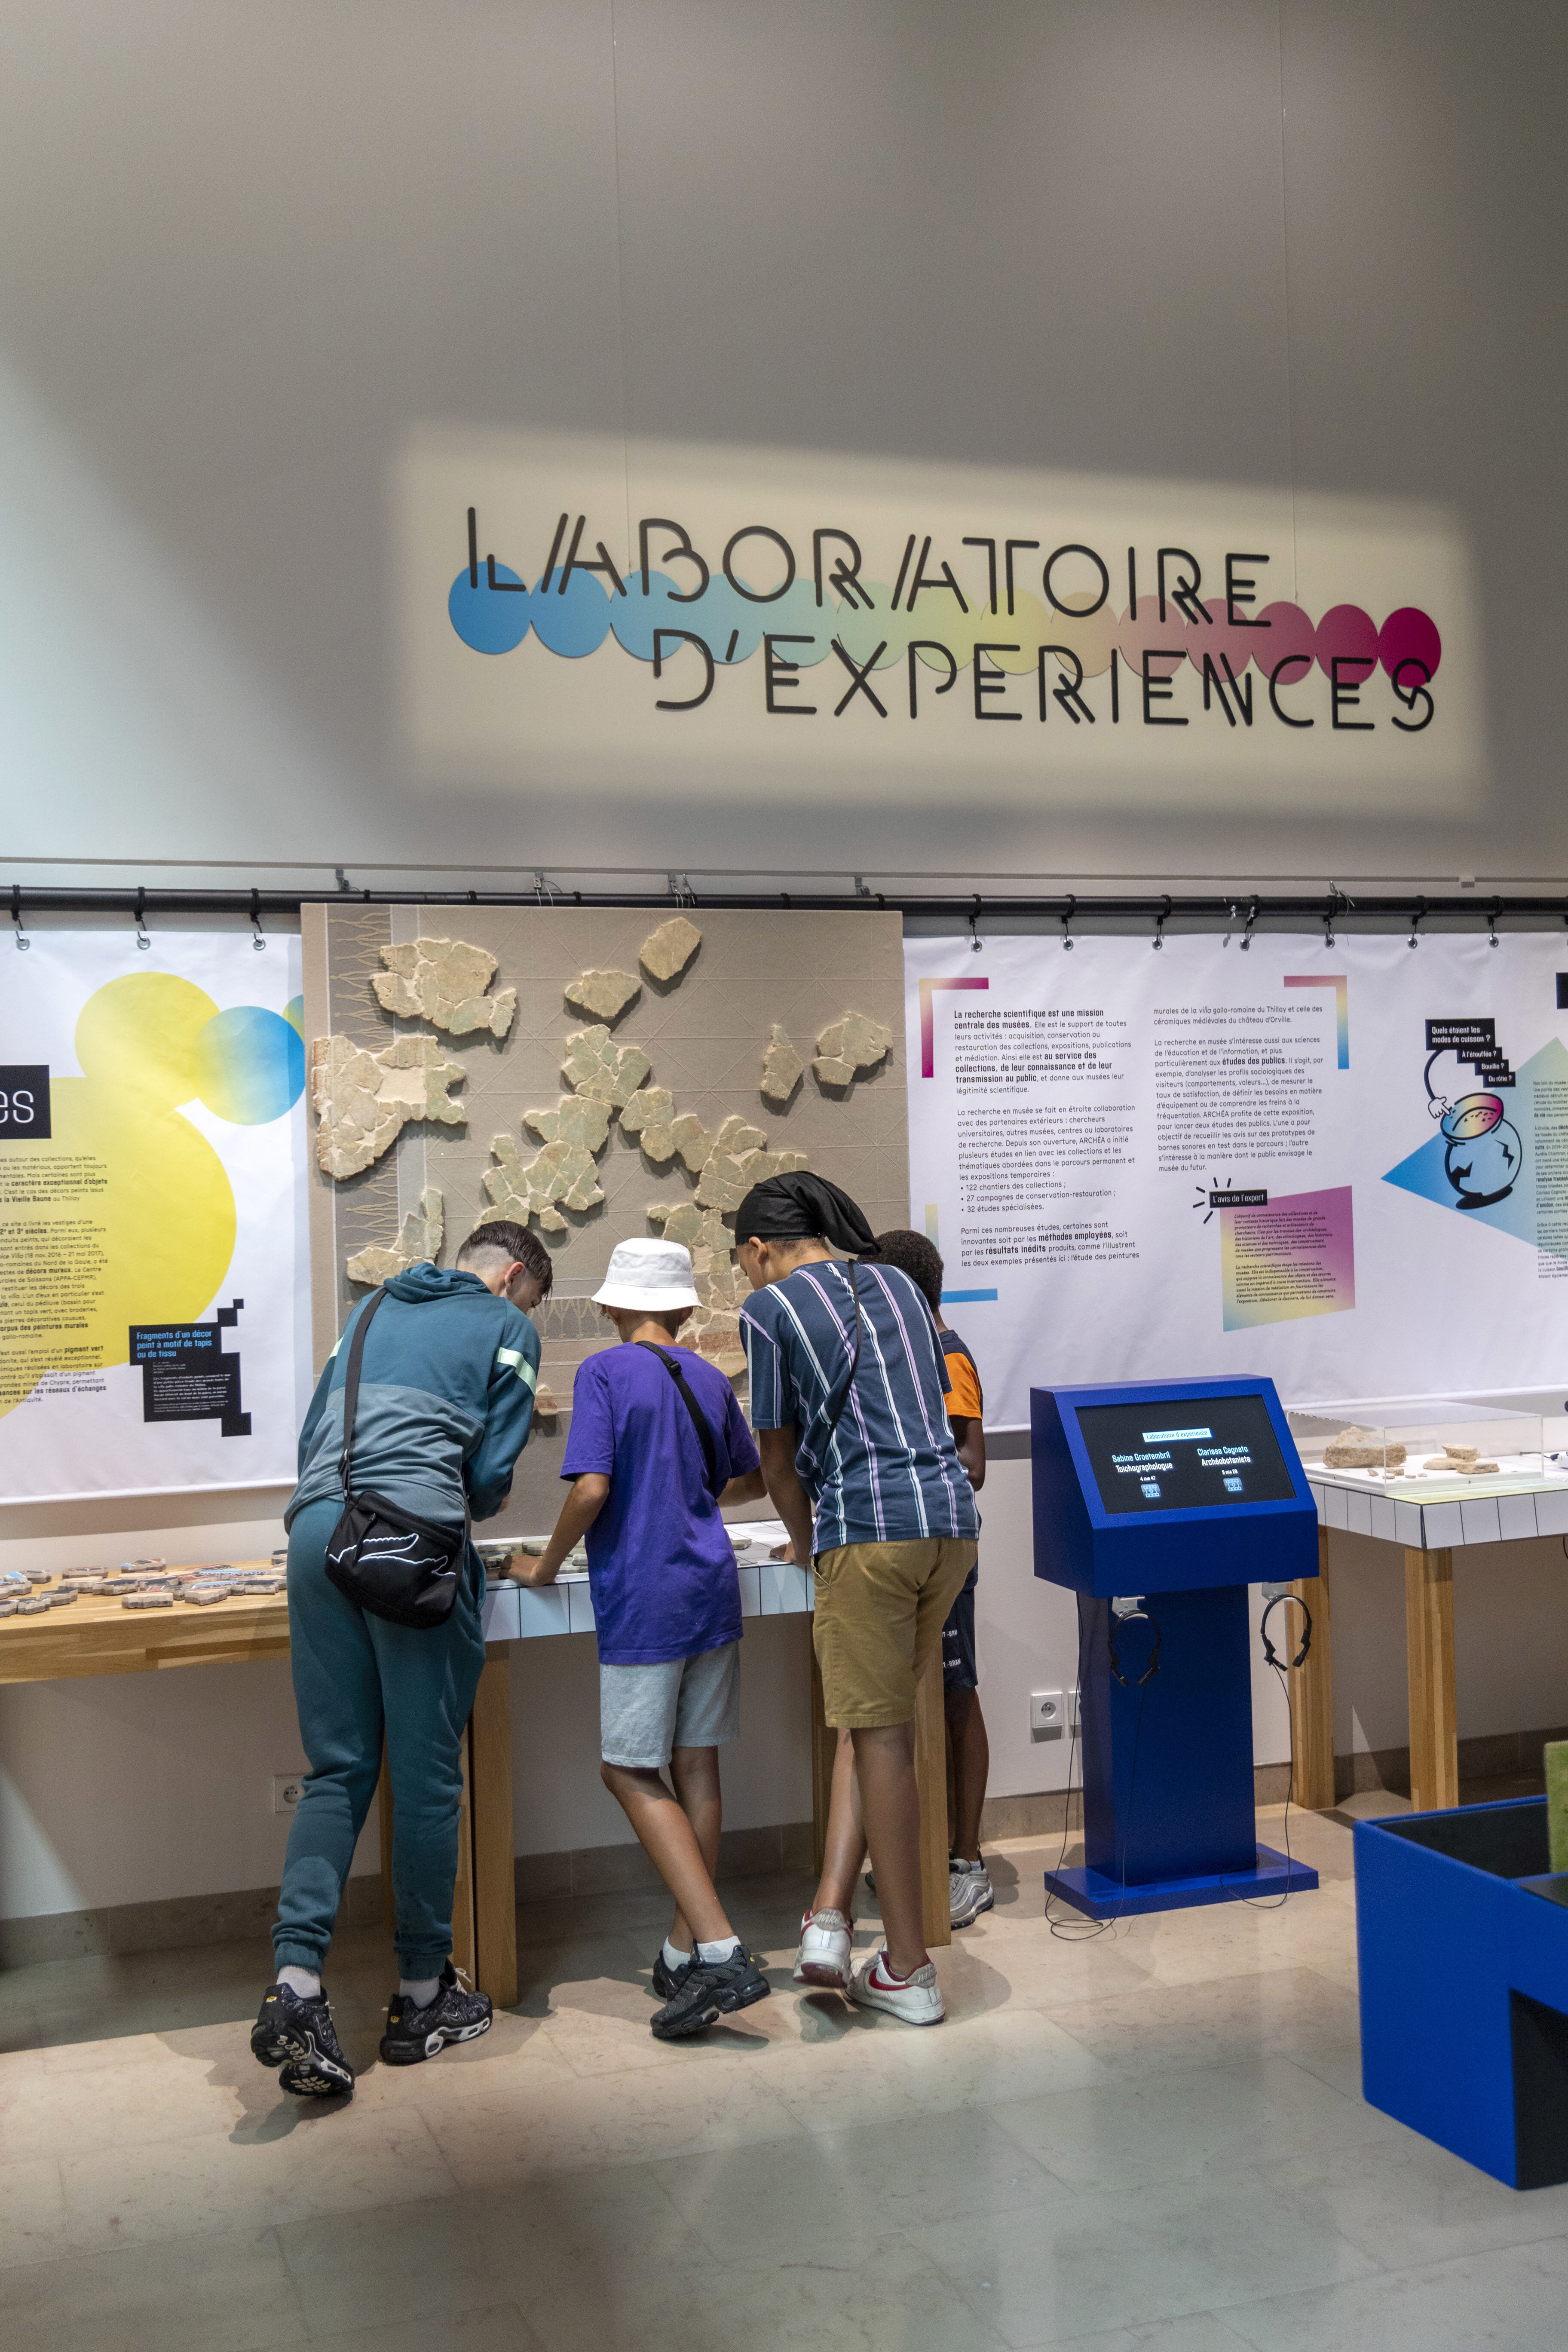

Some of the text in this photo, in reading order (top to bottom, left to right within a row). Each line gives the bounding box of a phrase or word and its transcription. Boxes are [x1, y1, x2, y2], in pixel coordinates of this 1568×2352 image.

[468, 506, 1271, 628] LABORATOIRE
[653, 629, 1435, 732] D'EXPERIENCES
[965, 1010, 1001, 1018] recherche
[1003, 1009, 1045, 1019] scientifique
[1213, 1006, 1255, 1014] gallo-romaine
[954, 1020, 984, 1029] centrale
[1002, 1020, 1031, 1028] musées.
[1154, 1017, 1191, 1026] céramiques
[1432, 1026, 1447, 1035] Quels
[1008, 1032, 1045, 1040] acquisition,
[1051, 1041, 1090, 1050] expositions,
[1092, 1041, 1131, 1049] publications
[1084, 1050, 1096, 1059] des
[956, 1064, 997, 1072] collections,
[1099, 1061, 1112, 1069] leur
[1155, 1059, 1207, 1068] particulièrement
[1222, 1057, 1245, 1065] études
[1262, 1057, 1286, 1066] publics.
[1016, 1073, 1038, 1083] public,
[956, 1086, 987, 1095] légitimité
[1026, 1180, 1062, 1188] collections
[1241, 1194, 1263, 1203] l'expert
[136, 1332, 173, 1341] Fragments
[137, 1341, 155, 1350] peint
[1222, 1446, 1248, 1455] Cagnato
[1112, 1451, 1170, 1462] Sabine Groetembril
[1201, 1455, 1251, 1466] Archéobotaniste
[1115, 1462, 1173, 1472] Toichographologue
